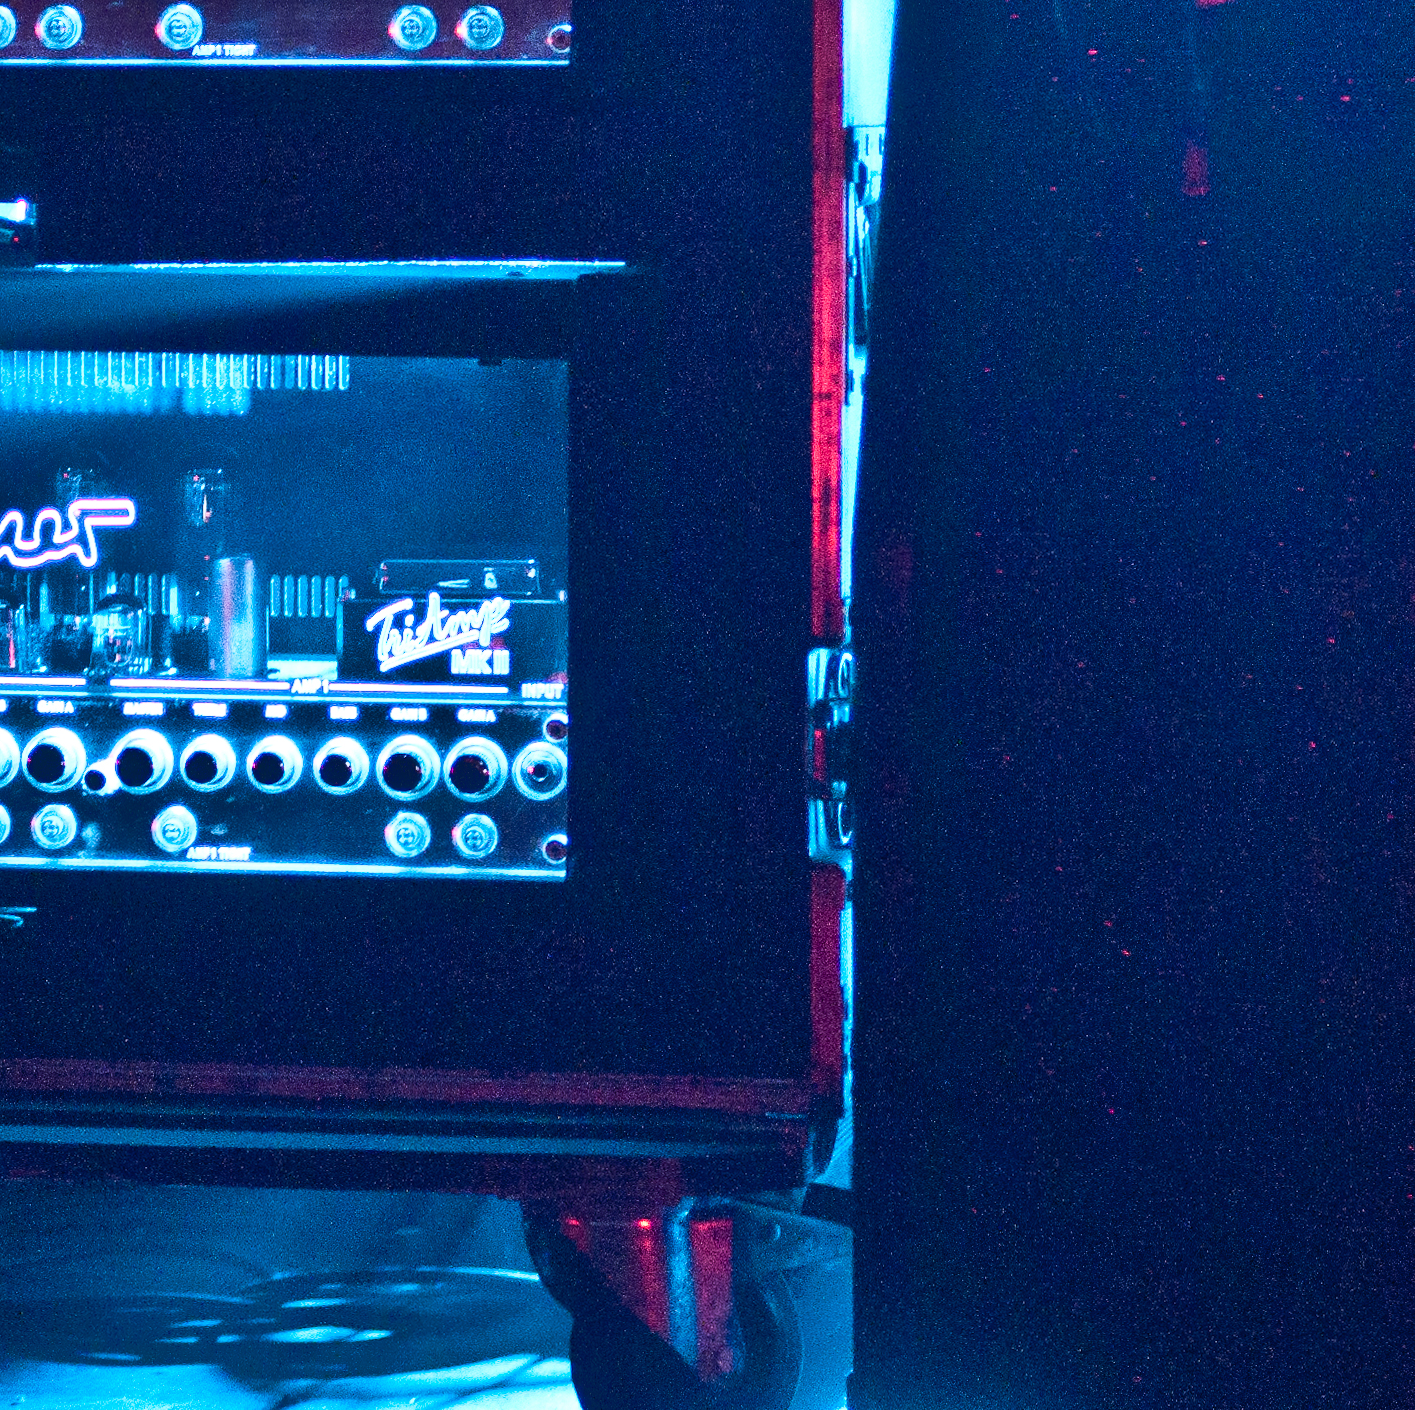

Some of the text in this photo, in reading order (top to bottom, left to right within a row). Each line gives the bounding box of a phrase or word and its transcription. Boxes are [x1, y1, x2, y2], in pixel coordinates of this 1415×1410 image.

[291, 679, 329, 693] AMP 1
[521, 683, 565, 699] INPUT
